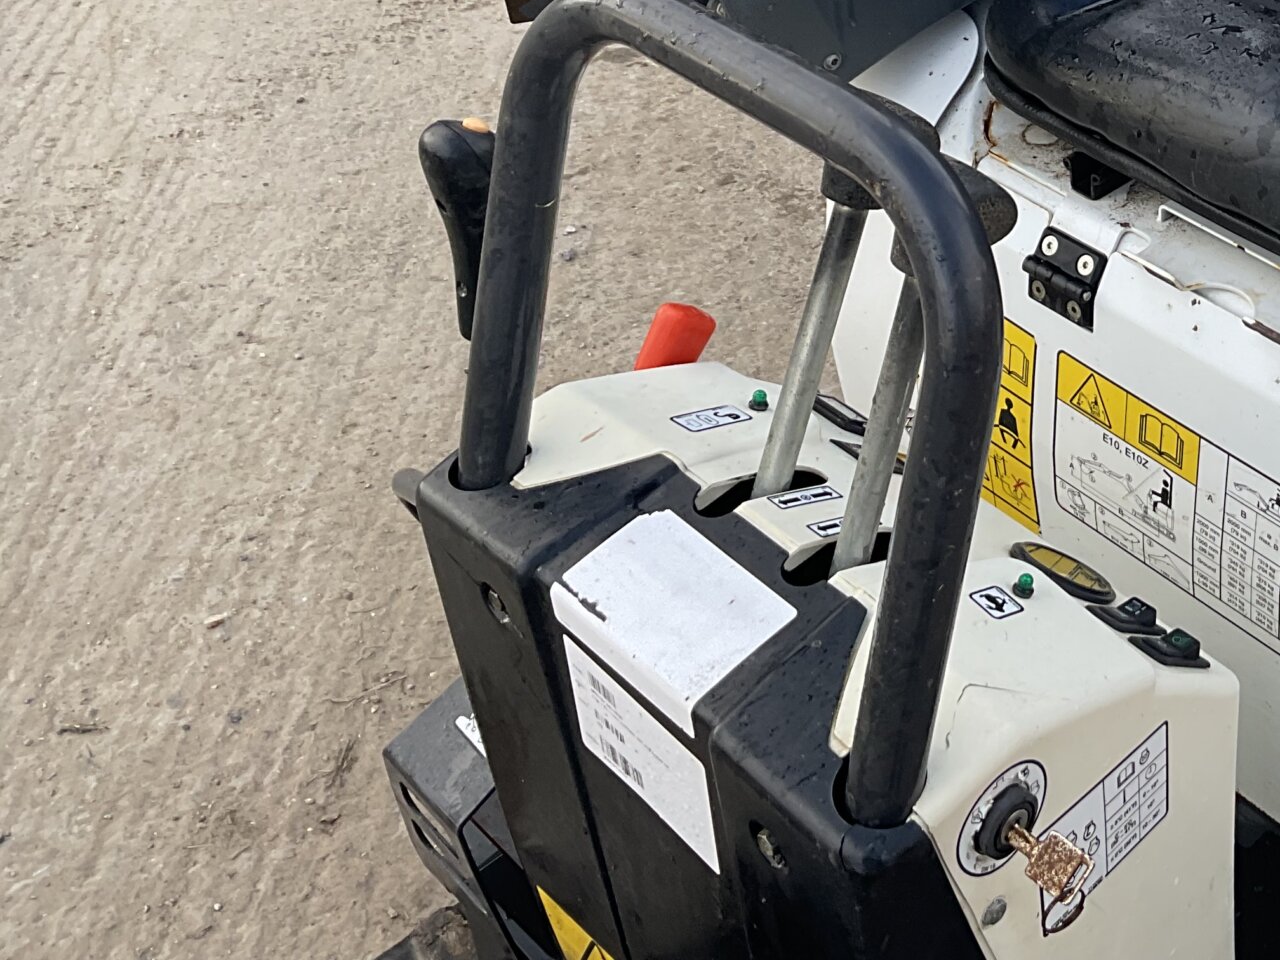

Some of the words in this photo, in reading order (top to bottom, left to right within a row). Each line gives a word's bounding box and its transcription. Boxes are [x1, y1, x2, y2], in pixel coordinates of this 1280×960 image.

[1102, 432, 1122, 454] E10,
[1124, 447, 1150, 470] E10Z
[1207, 494, 1214, 503] A
[1240, 510, 1247, 519] B
